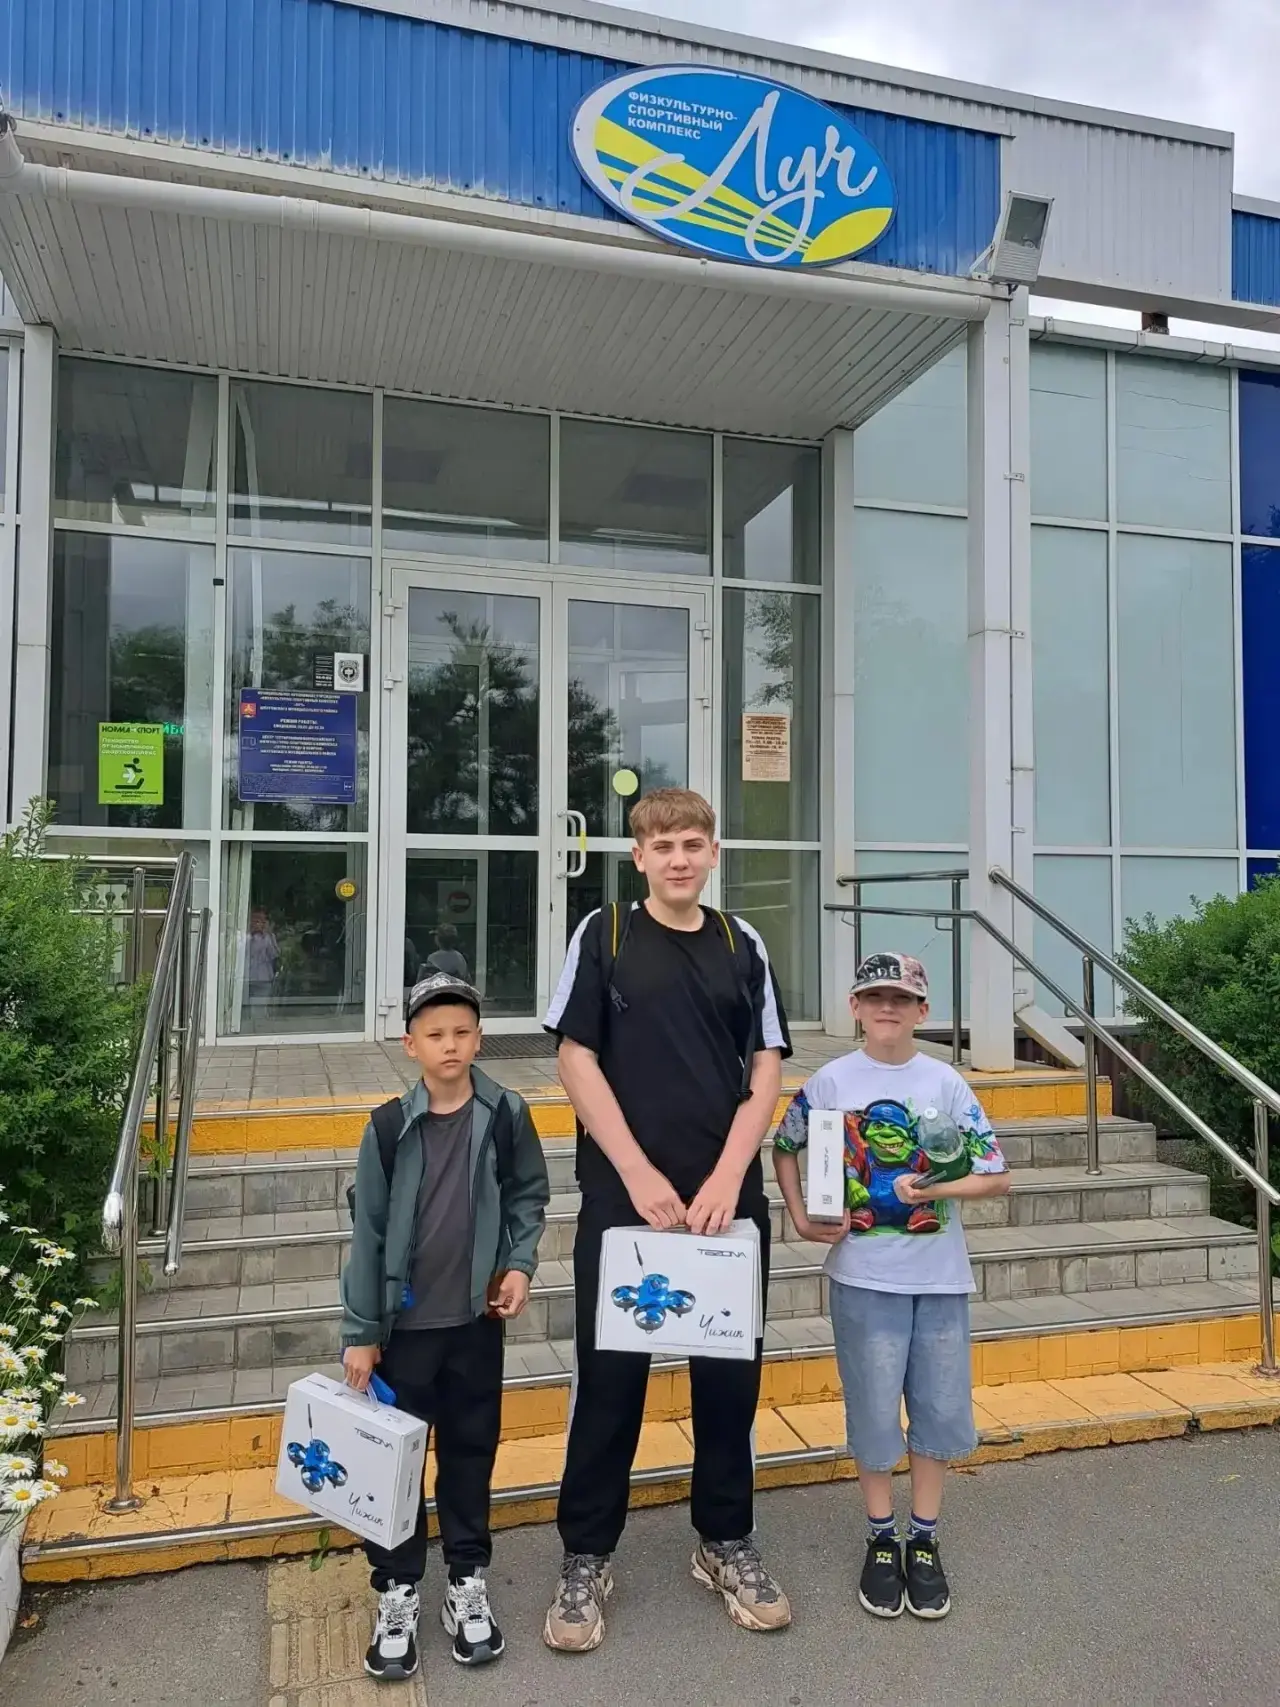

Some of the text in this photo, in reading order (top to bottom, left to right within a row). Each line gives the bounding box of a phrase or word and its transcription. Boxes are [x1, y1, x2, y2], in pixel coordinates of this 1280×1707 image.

[628, 91, 738, 120] ФИЗКУЛЬТУРНО-
[628, 104, 723, 131] СПОРТИВНЫЙ
[628, 117, 701, 139] КОМПЛЕКС
[620, 90, 878, 263] Луч
